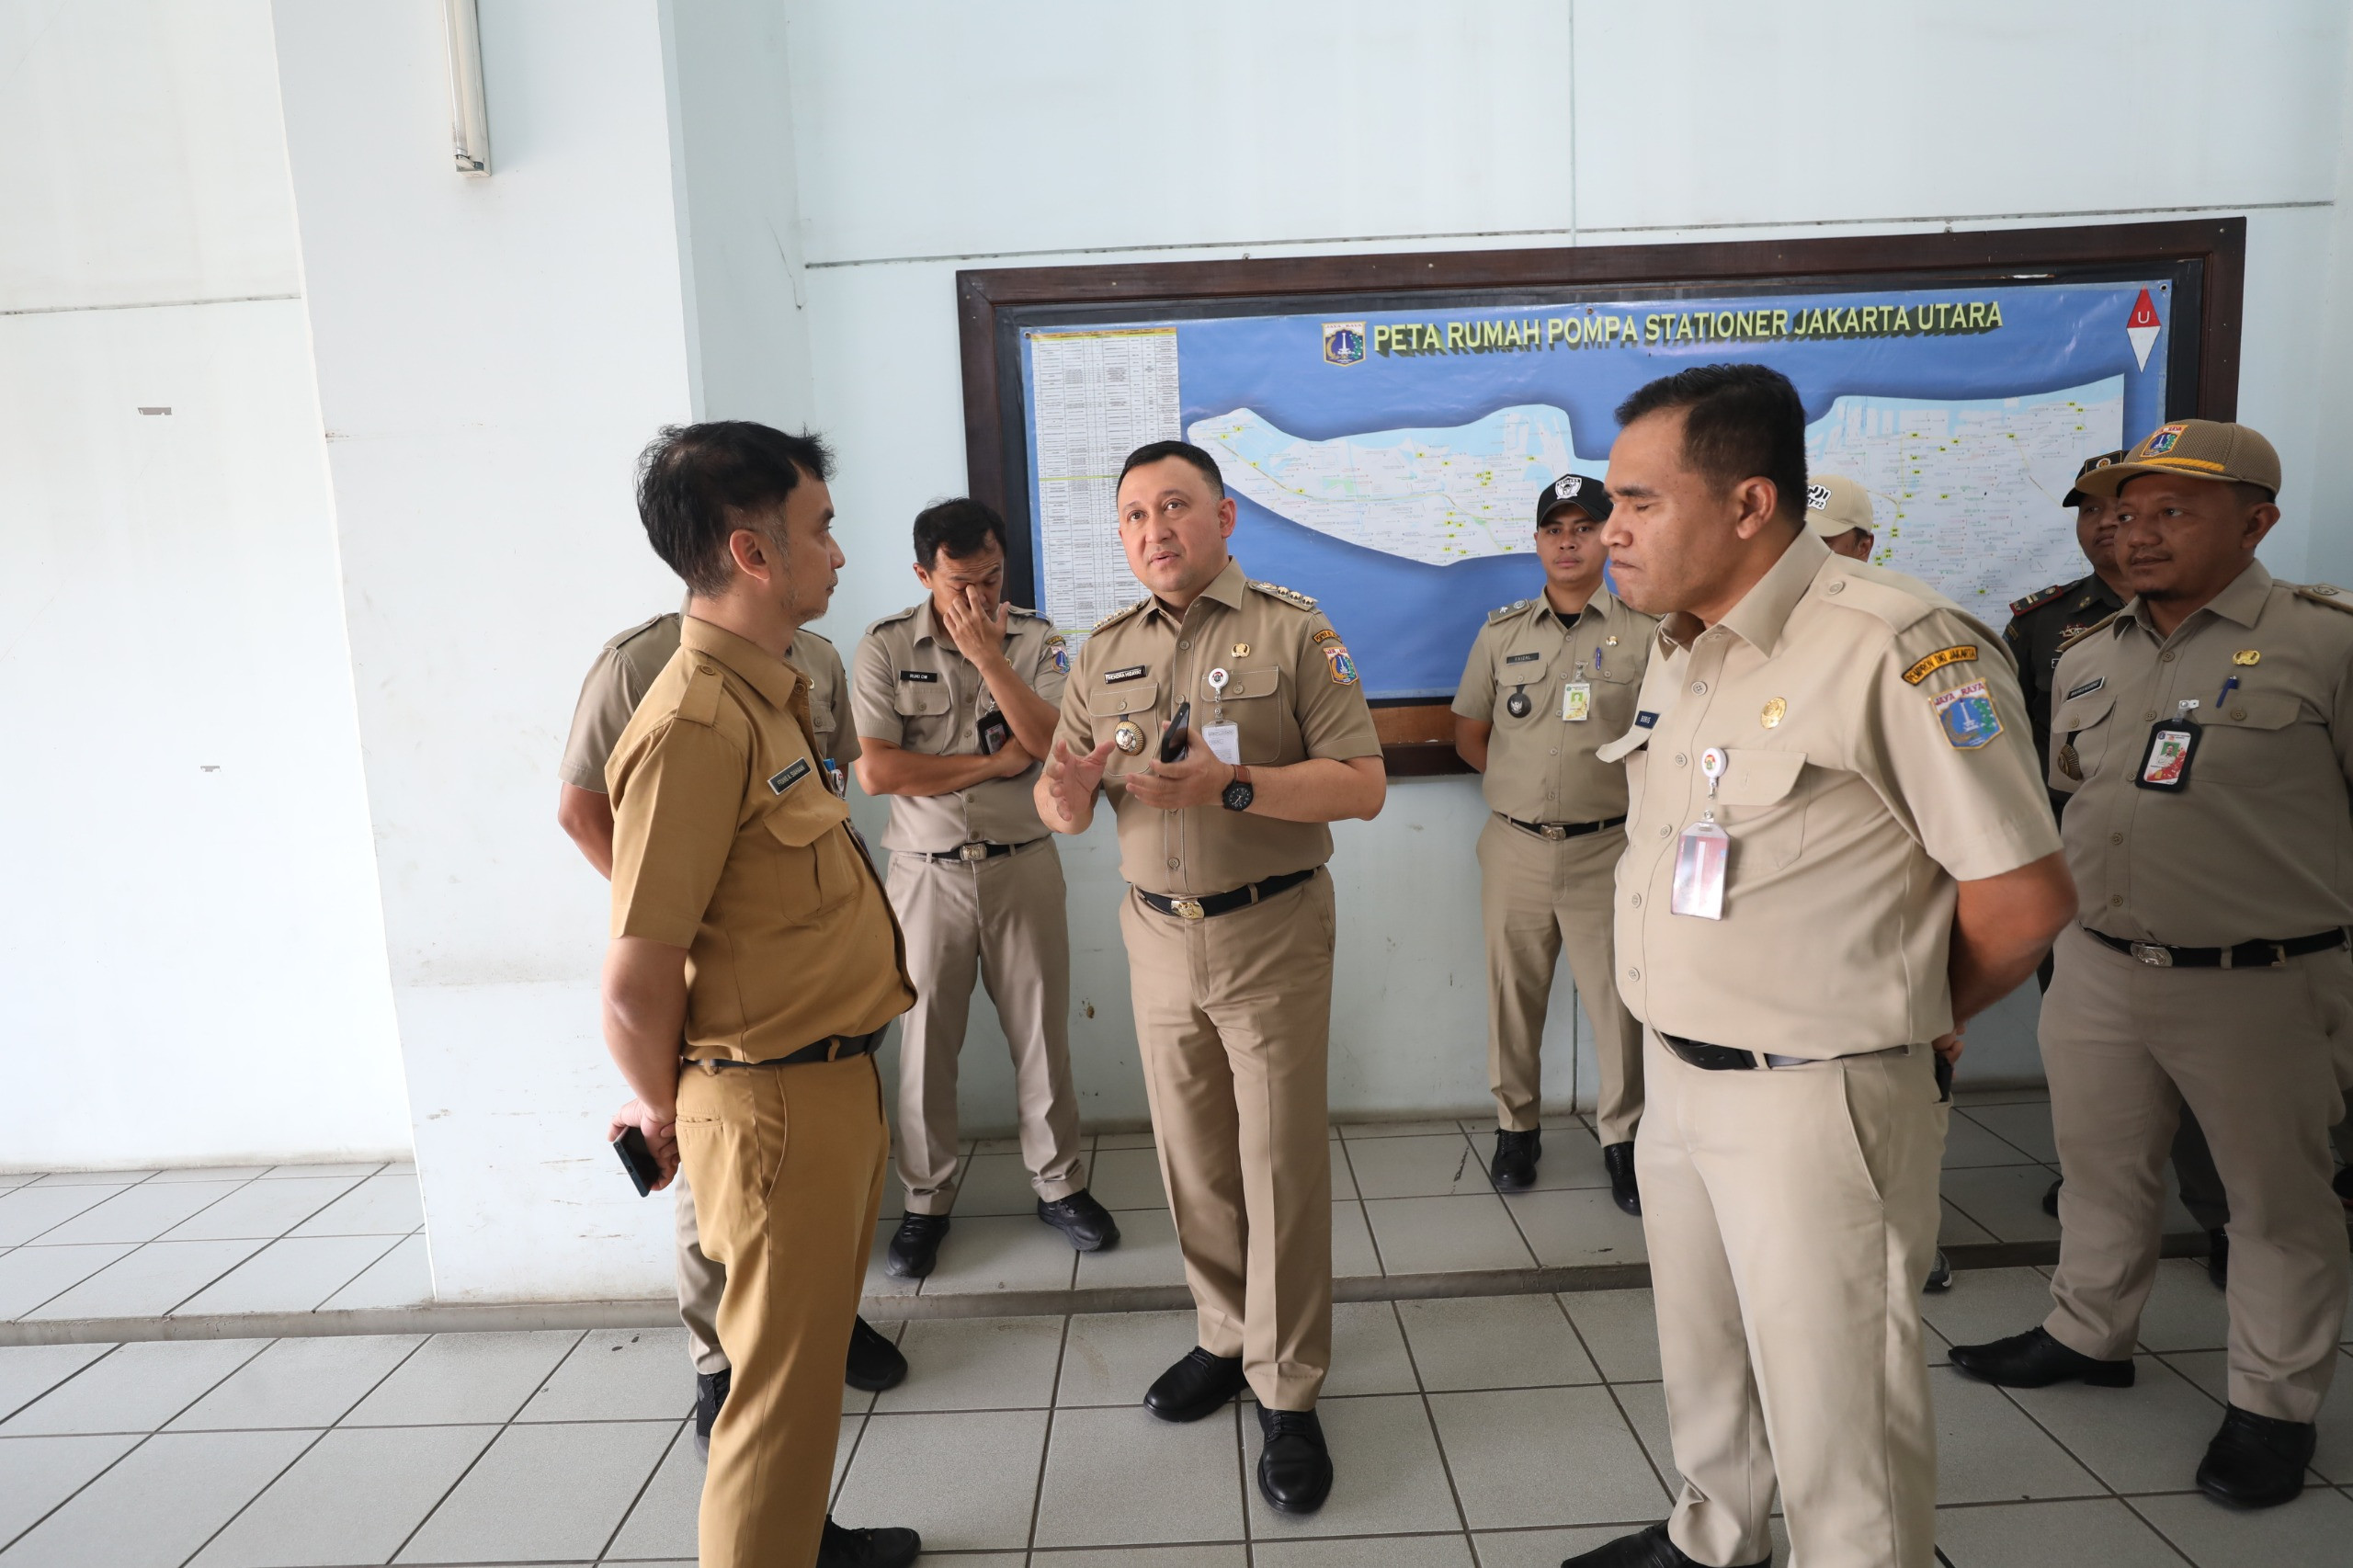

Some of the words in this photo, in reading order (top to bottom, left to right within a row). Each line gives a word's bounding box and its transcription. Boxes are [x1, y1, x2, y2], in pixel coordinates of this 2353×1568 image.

[1373, 323, 1443, 351] PETA
[1448, 319, 1541, 349] RUMAH
[1548, 315, 1638, 345] POMPA
[1645, 309, 1789, 341] STATIONER
[1794, 304, 1912, 335] JAKARTA
[1916, 301, 2004, 331] UTARA
[2137, 310, 2151, 324] U
[1935, 652, 1949, 664] DKI
[1949, 648, 1976, 660] JAKARTA
[1935, 692, 1956, 706] JAYA
[1961, 682, 1985, 696] RAYA
